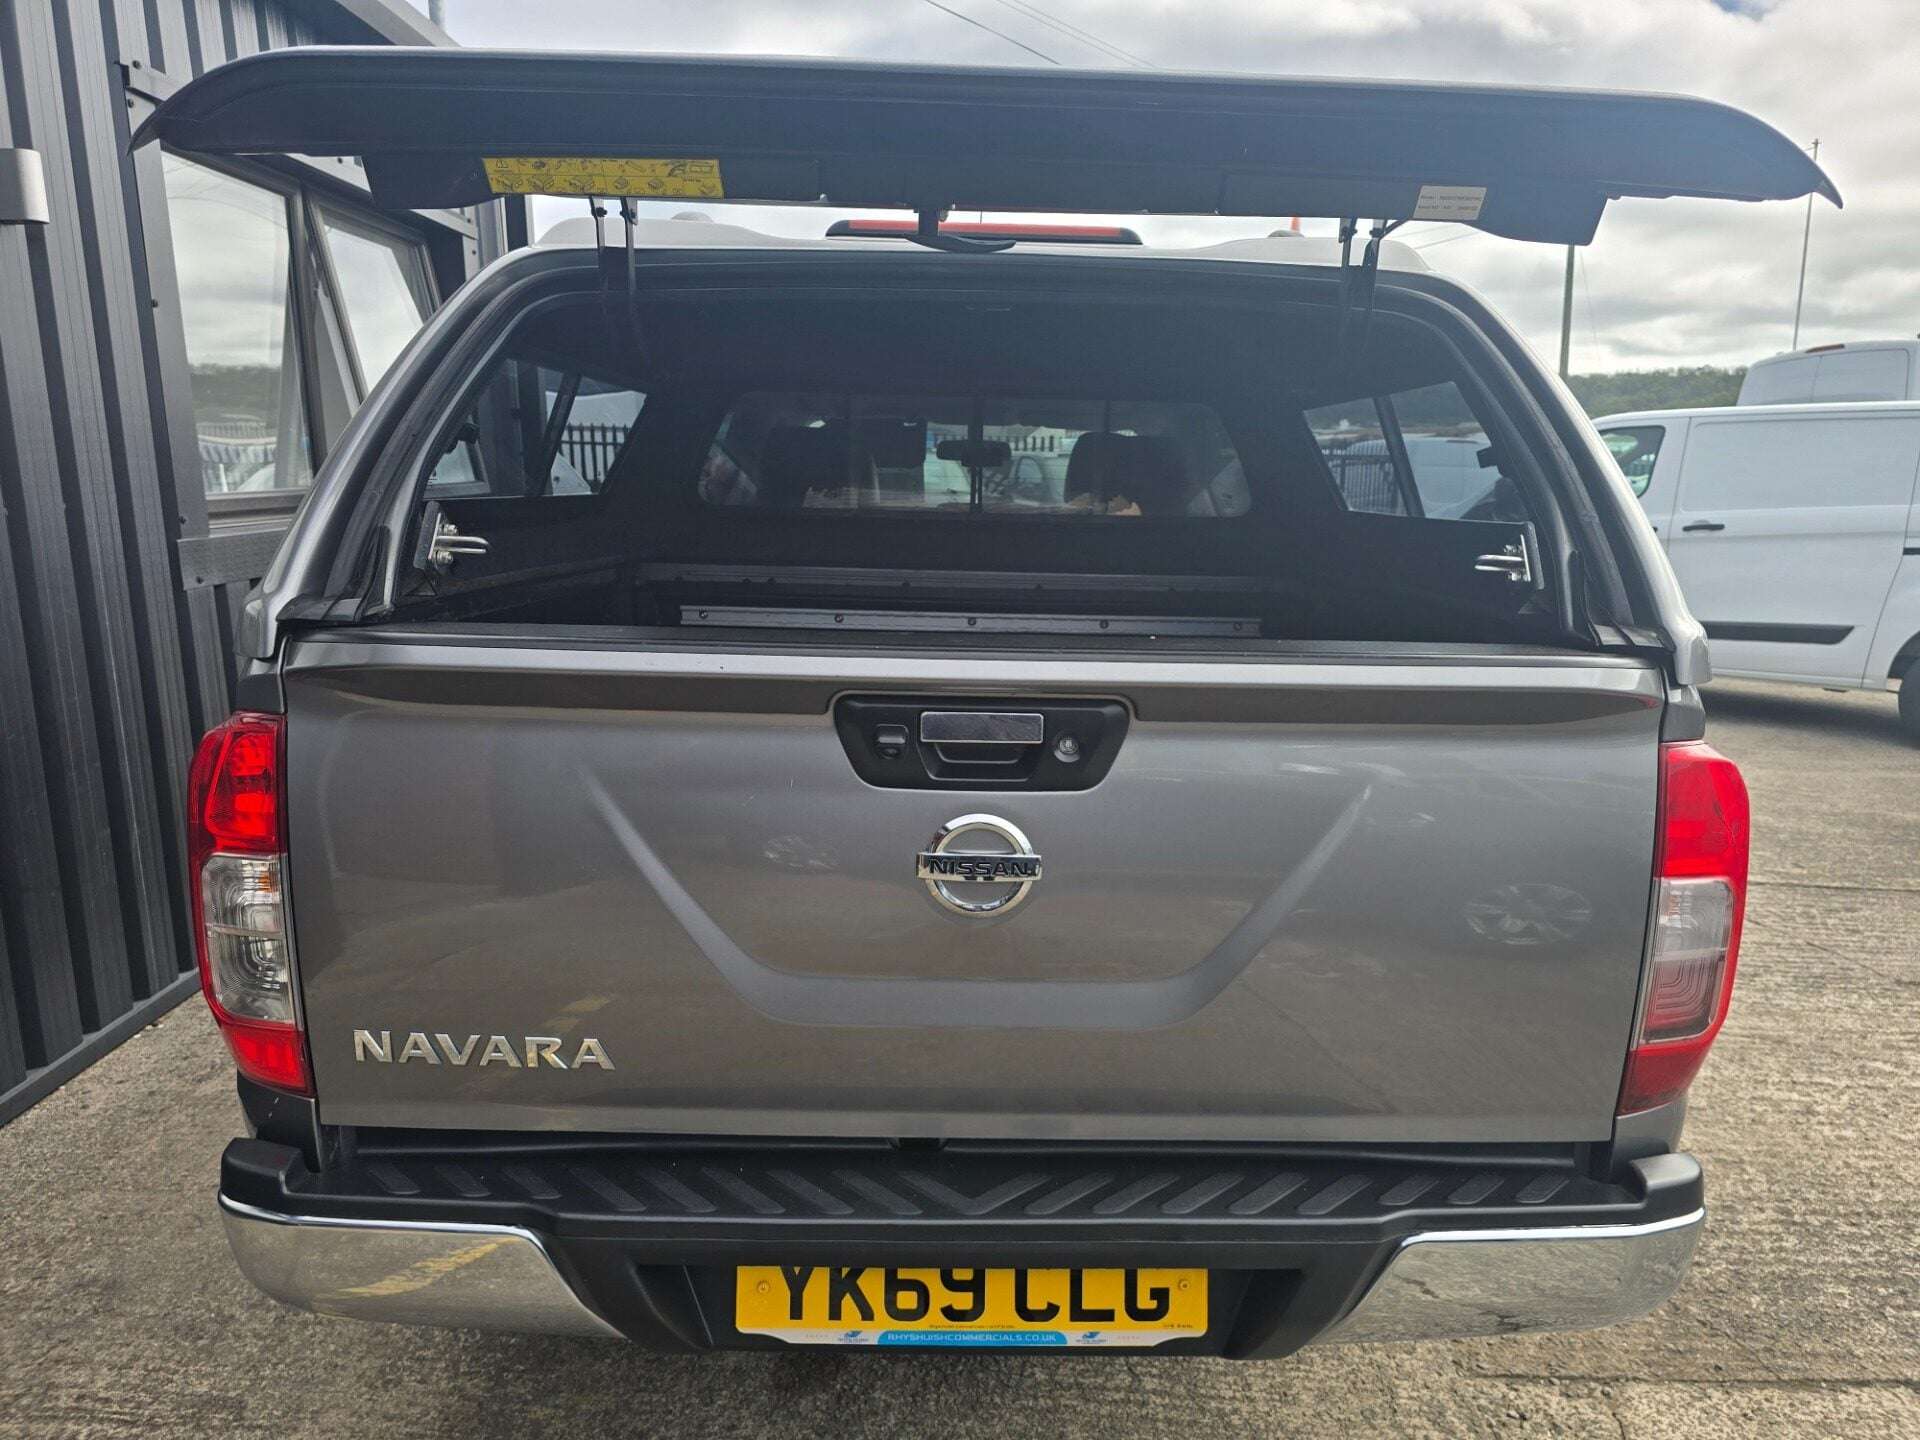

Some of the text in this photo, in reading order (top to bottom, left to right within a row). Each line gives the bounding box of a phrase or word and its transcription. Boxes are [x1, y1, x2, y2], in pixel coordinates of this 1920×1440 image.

[929, 857, 1038, 877] NISSAN
[353, 1029, 616, 1070] NAVARA
[780, 1266, 1170, 1322] YK69 CLG
